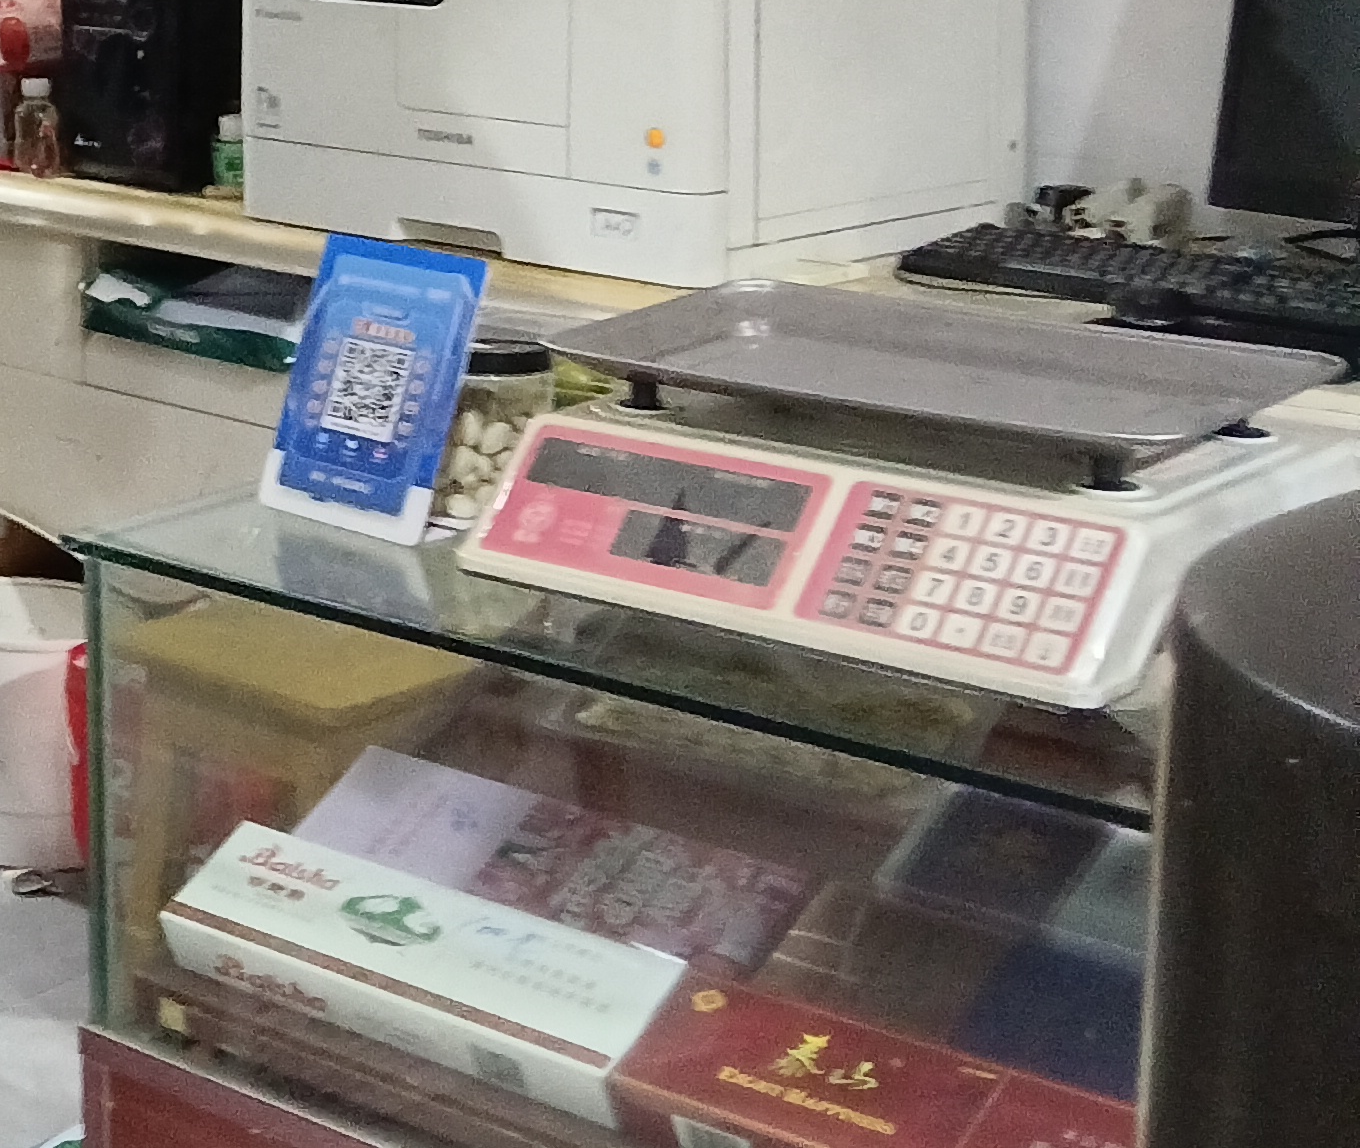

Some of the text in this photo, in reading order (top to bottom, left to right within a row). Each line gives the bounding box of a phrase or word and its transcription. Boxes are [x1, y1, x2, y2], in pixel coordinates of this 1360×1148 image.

[997, 518, 1016, 540] 2
[1037, 526, 1058, 547] 3
[939, 544, 1045, 582] 4 5 6
[928, 577, 1036, 616] 7 8 9
